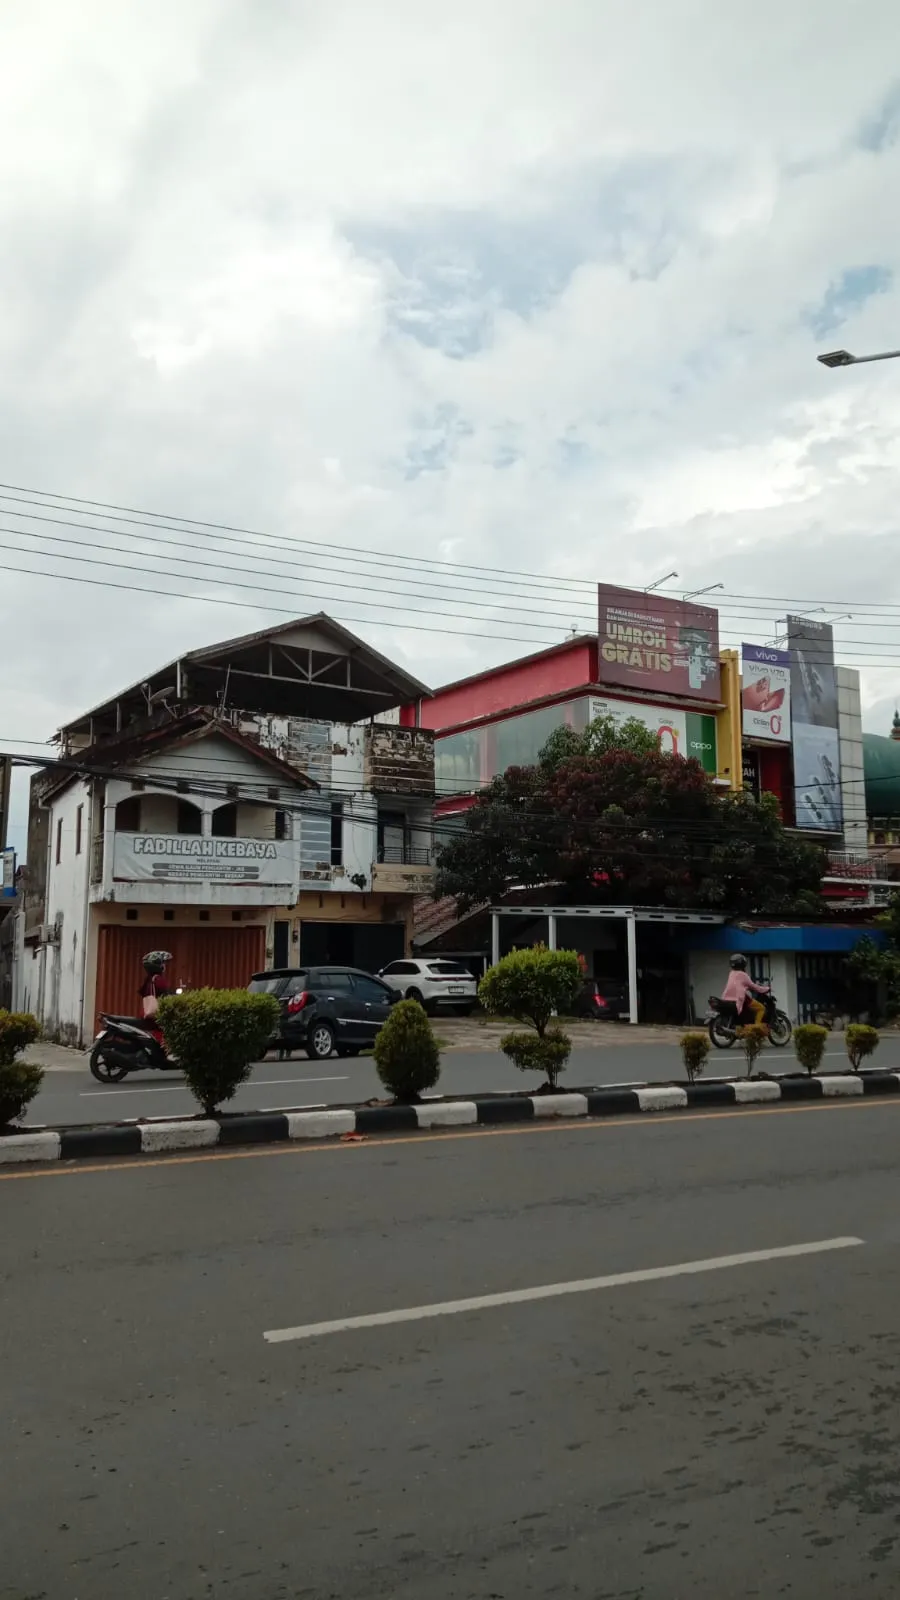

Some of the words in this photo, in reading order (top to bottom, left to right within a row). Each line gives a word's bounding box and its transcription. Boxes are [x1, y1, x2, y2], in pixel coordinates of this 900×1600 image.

[606, 622, 667, 649] UMROH
[601, 642, 672, 672] GRATIS
[755, 650, 778, 662] vivo
[748, 664, 769, 673] vivo
[690, 741, 712, 750] oppo
[742, 767, 755, 777] AH
[133, 837, 213, 857] FADILLAH
[215, 842, 277, 859] KEBAYA
